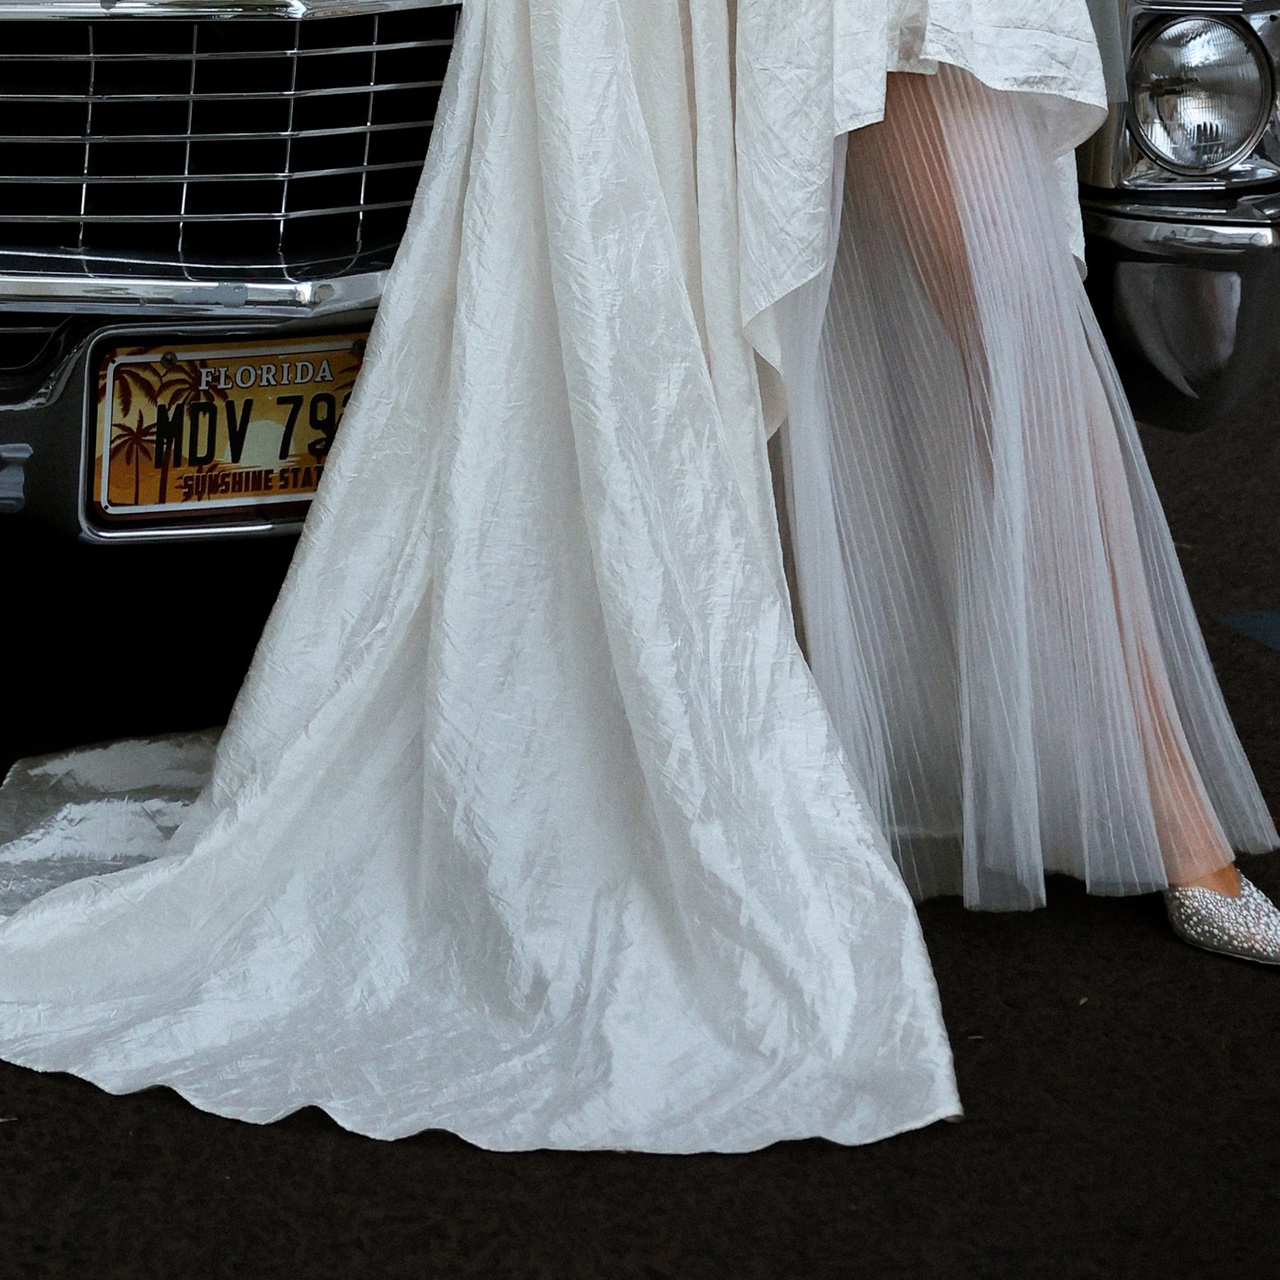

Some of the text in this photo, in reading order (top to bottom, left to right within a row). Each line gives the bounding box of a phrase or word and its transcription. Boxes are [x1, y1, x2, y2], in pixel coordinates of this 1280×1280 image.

[198, 358, 334, 391] FLORIDA
[154, 391, 352, 469] MDV 79
[182, 465, 326, 496] SUNSHINE STAT
